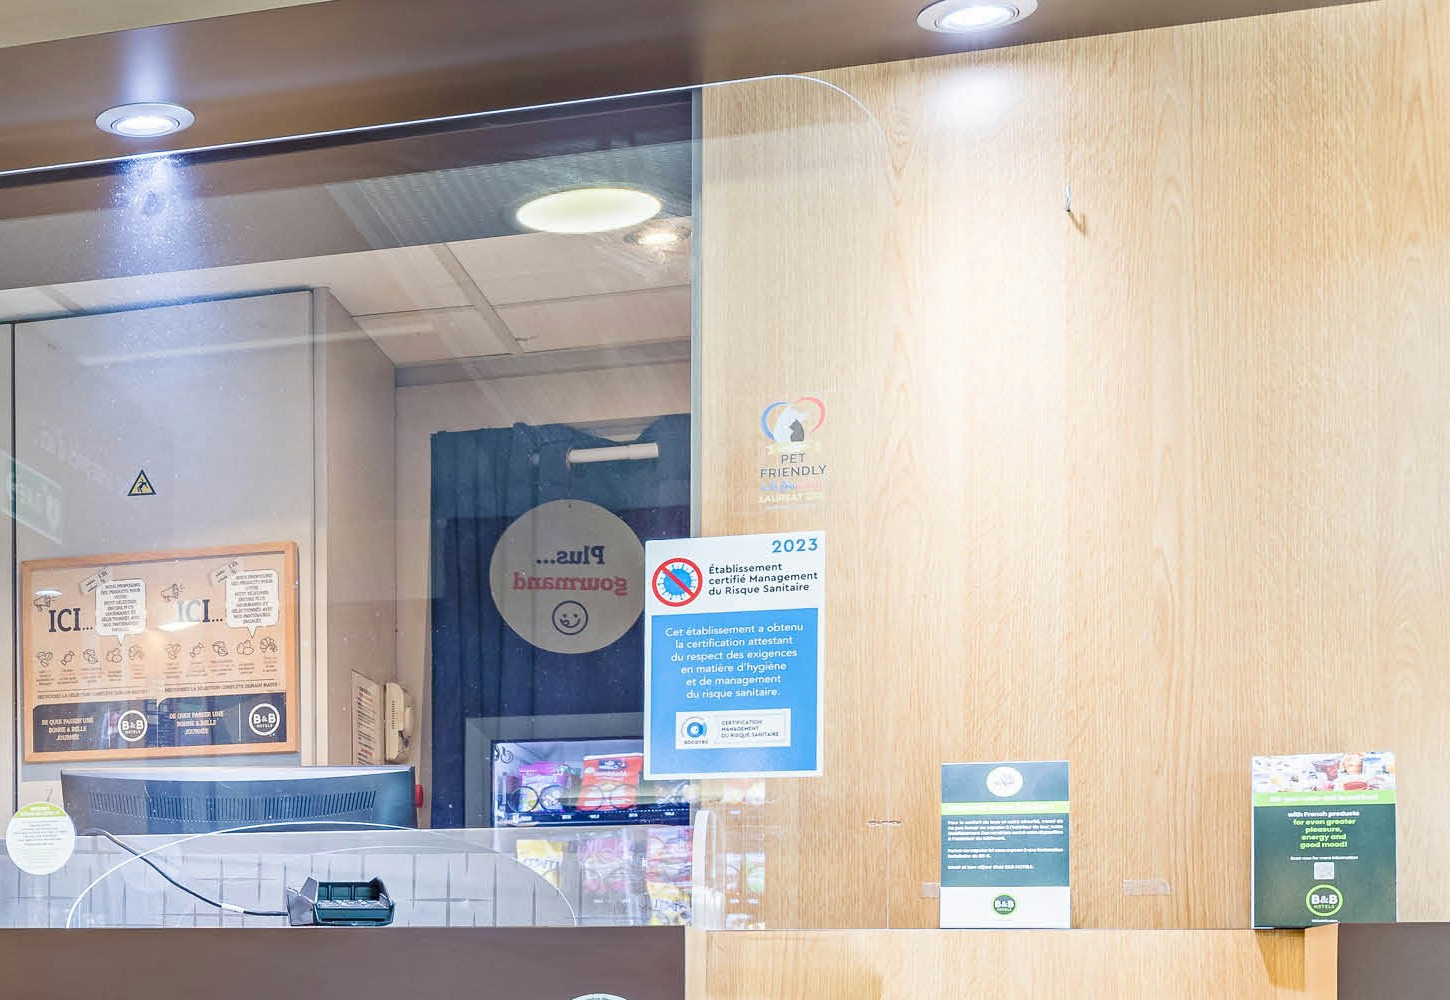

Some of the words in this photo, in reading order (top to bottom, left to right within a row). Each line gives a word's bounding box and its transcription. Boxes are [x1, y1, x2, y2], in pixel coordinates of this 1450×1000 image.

[781, 453, 806, 464] PET
[760, 464, 826, 478] FRIENDLY
[772, 538, 818, 553] 2023
[709, 563, 783, 574] Établissement
[708, 574, 746, 585] certifié
[749, 572, 818, 586] Management
[708, 586, 721, 596] du
[725, 584, 760, 597] Risque
[763, 583, 809, 593] Sanitaire
[176, 599, 223, 623] ICI...
[48, 608, 93, 633] ICI...
[665, 627, 683, 637] Cet
[686, 625, 755, 636] établissement
[767, 623, 804, 632] obtenu
[675, 639, 684, 649] la
[686, 637, 745, 648] certification
[748, 636, 793, 646] attestant
[671, 652, 684, 662] du
[686, 652, 723, 663] respect
[726, 650, 744, 660] des
[747, 649, 797, 660] exigences
[681, 665, 693, 674] en
[696, 663, 733, 673] matière
[737, 661, 787, 674] d'hygiène
[686, 678, 696, 687] et
[699, 676, 712, 686] de
[715, 676, 781, 687] management
[686, 689, 699, 699] du
[702, 689, 732, 700] risque
[735, 688, 780, 697] sanitaire.
[253, 712, 276, 723] B&B
[122, 720, 144, 731] B&B
[1326, 818, 1356, 827] greater
[1305, 826, 1343, 835] pleasure,
[1301, 834, 1329, 842] energy
[1300, 842, 1320, 850] good
[995, 900, 1014, 908] B&B
[1311, 894, 1338, 905] B&B
